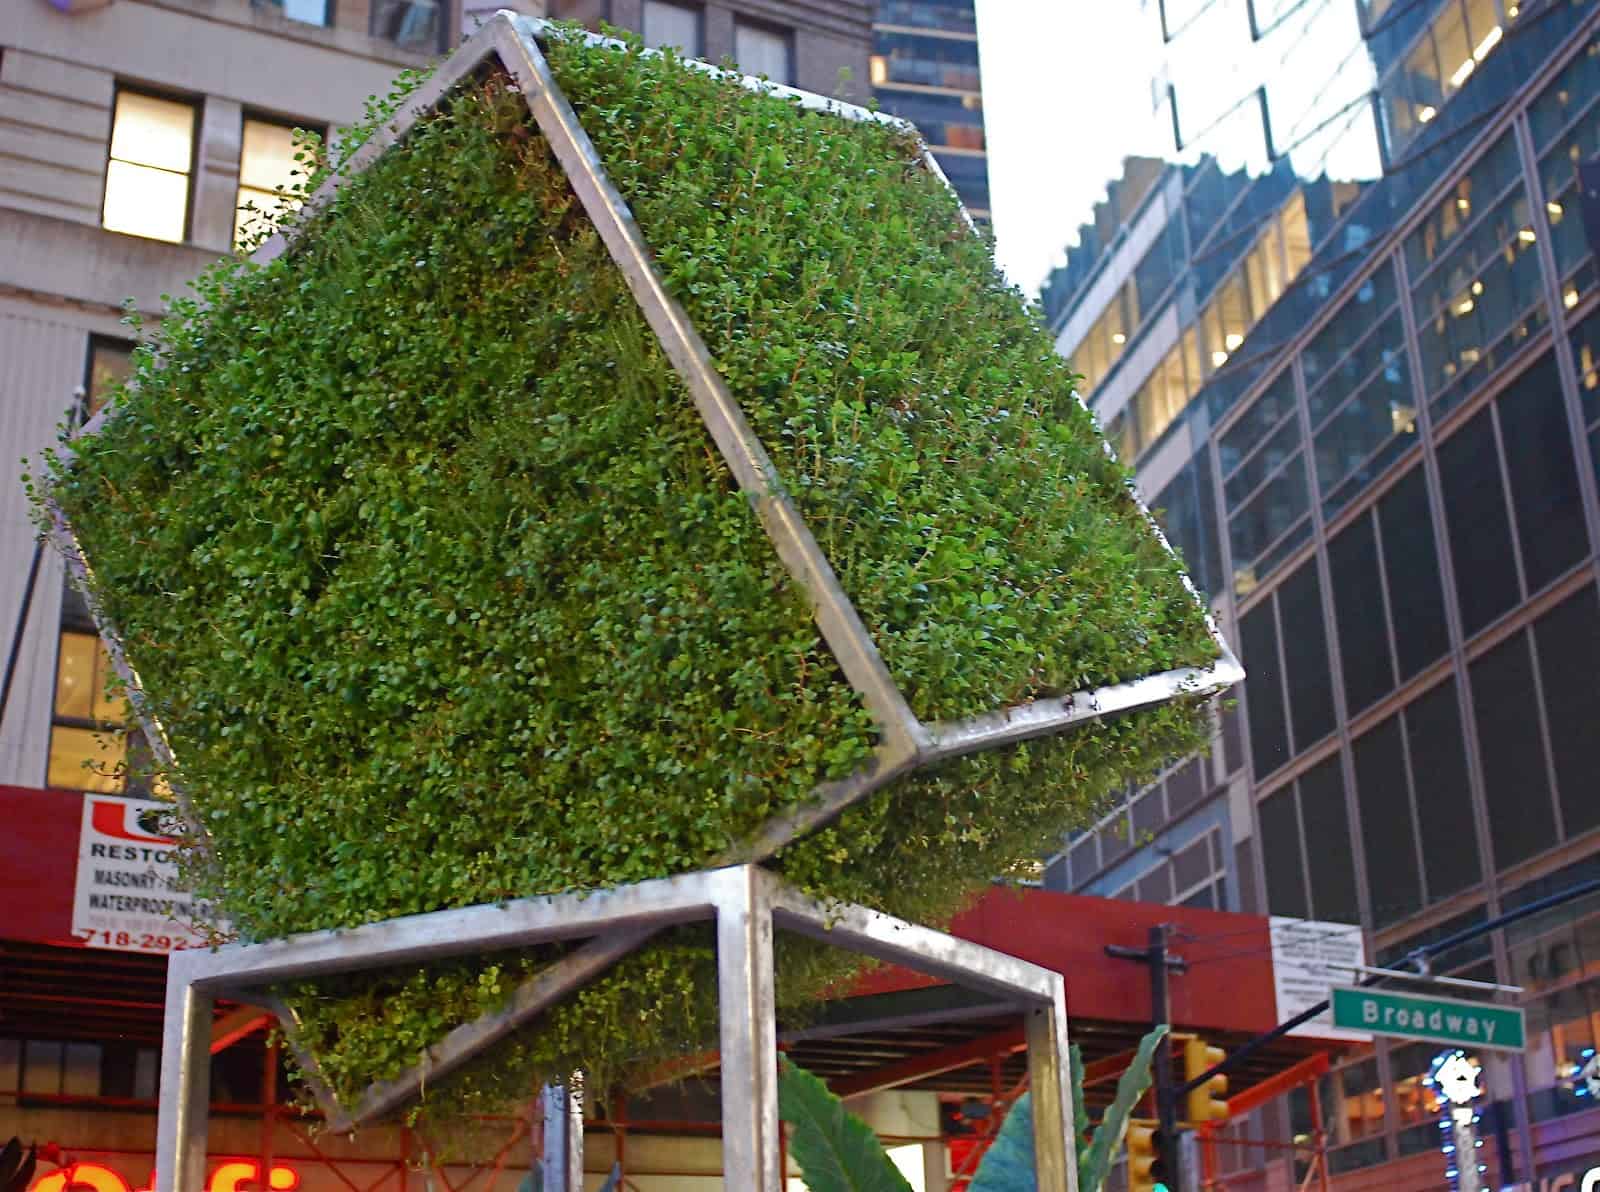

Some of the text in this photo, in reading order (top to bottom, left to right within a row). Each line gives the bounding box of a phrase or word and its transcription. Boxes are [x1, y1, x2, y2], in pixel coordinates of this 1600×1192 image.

[91, 843, 178, 864] RESTO
[94, 870, 155, 889] MASONRY
[1362, 1000, 1496, 1041] Broadway
